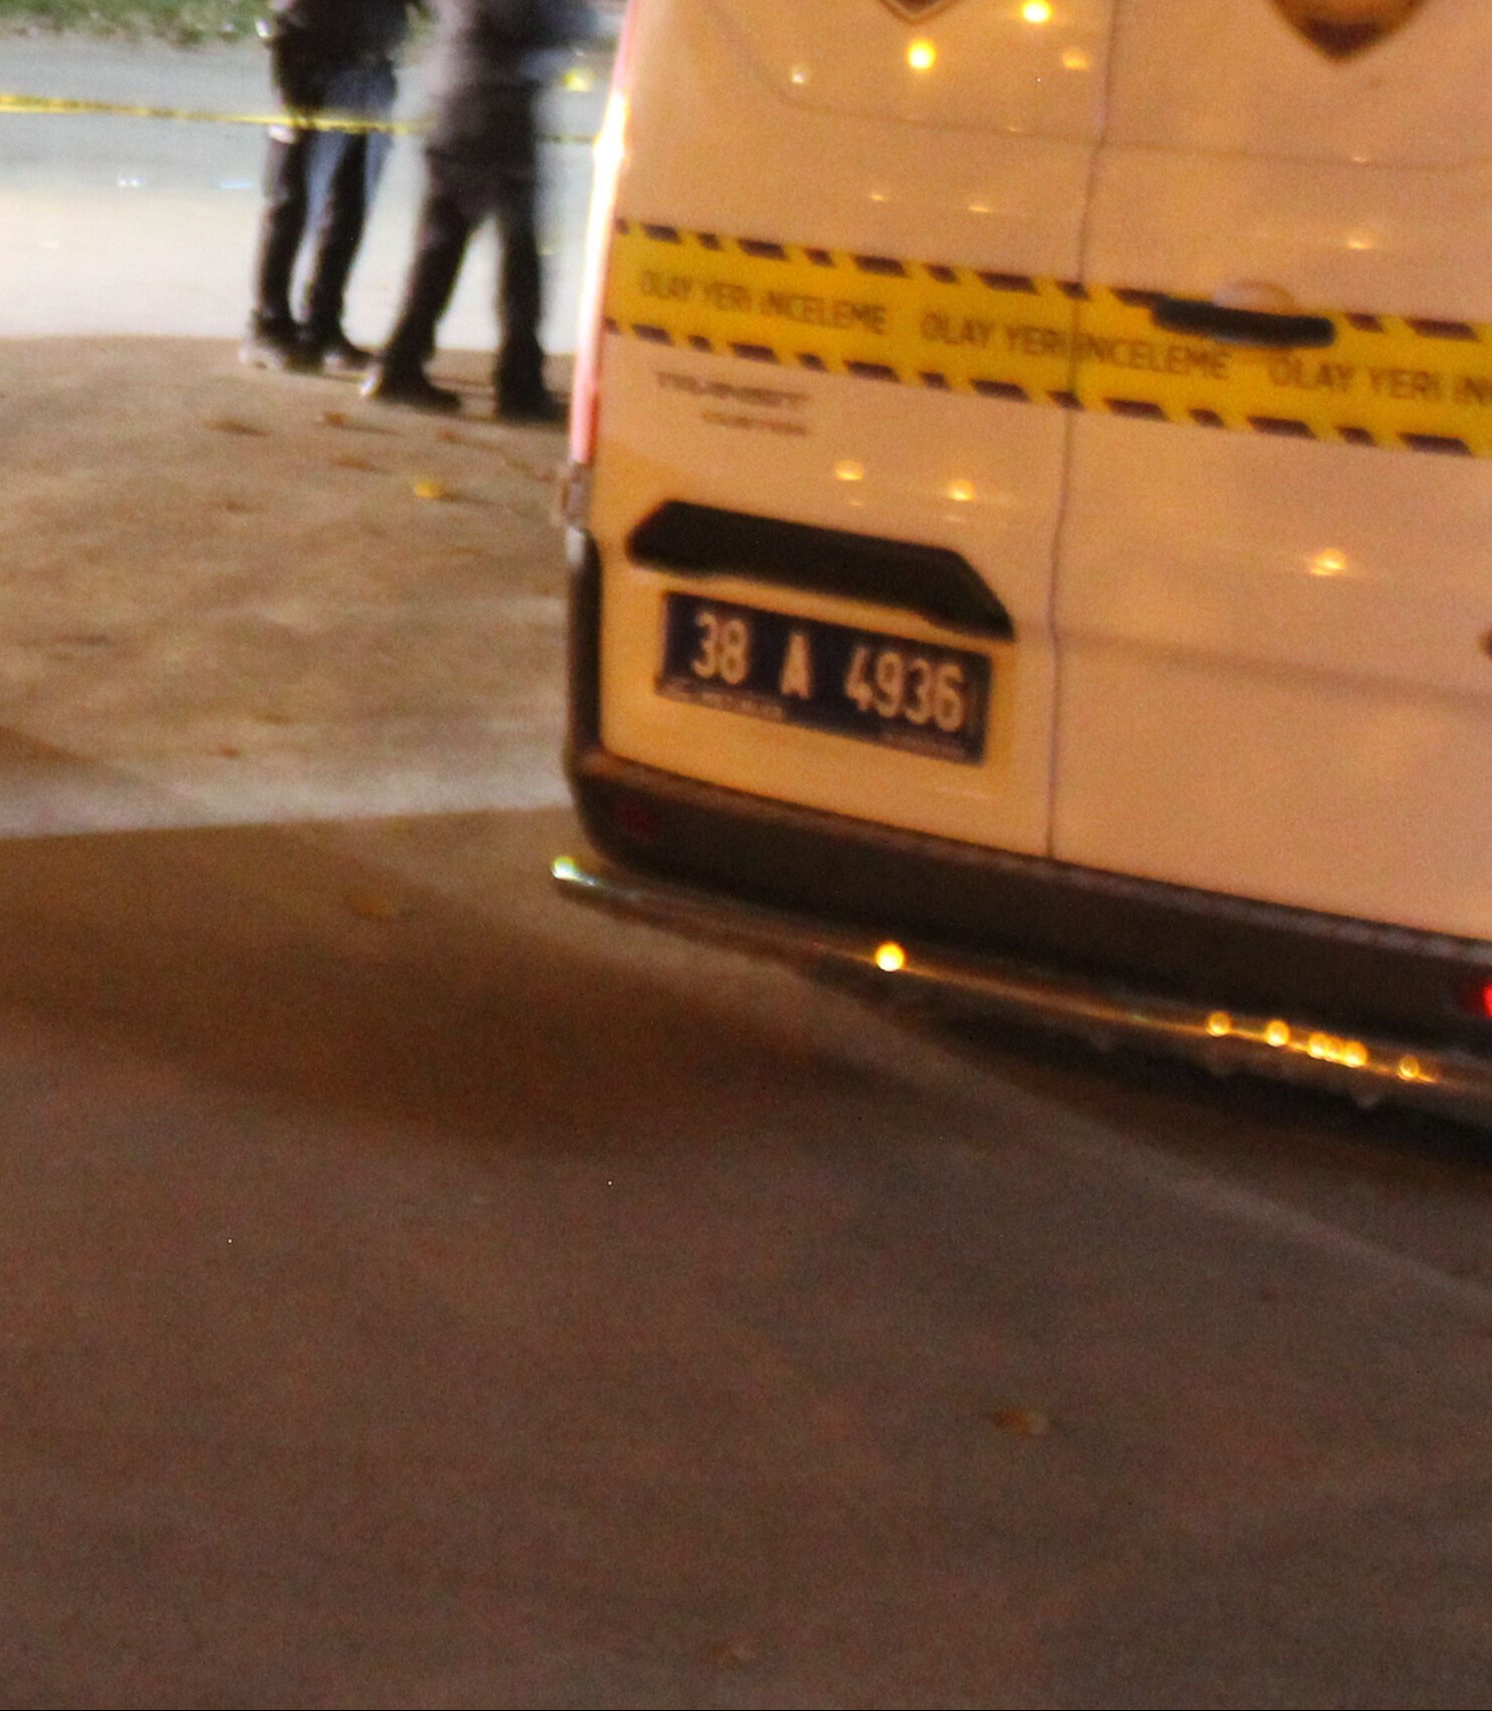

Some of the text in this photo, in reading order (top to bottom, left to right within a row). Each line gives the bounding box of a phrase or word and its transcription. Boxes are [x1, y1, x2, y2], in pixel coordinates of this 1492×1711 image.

[919, 308, 995, 349] OLAY
[691, 608, 752, 687] 38
[779, 631, 813, 702] A
[843, 642, 966, 733] 4936
